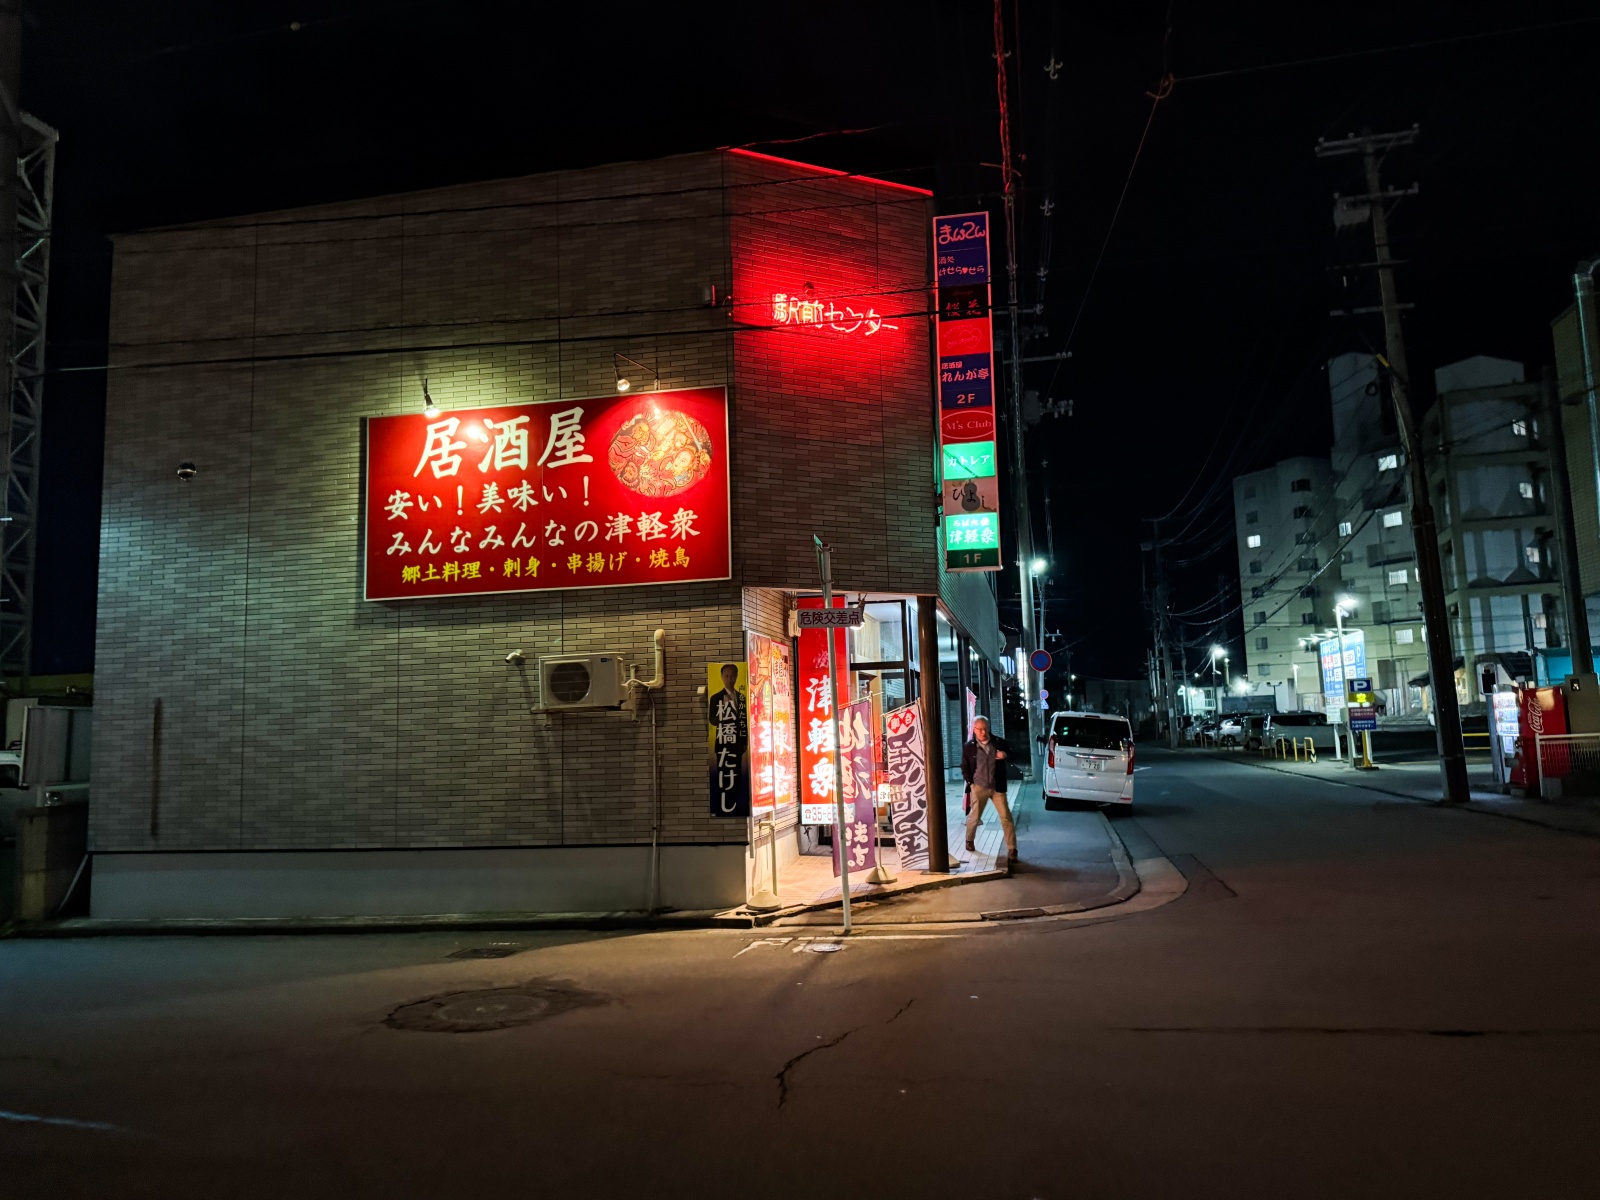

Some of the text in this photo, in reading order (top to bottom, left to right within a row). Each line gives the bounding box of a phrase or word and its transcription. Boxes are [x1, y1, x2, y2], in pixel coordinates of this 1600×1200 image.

[771, 293, 899, 336] 駅前センター
[941, 367, 990, 382] れんが亭
[957, 393, 976, 405] 2F
[946, 419, 992, 430] M's Club
[413, 406, 595, 480] 居酒屋
[948, 454, 991, 467] カトレア
[384, 475, 591, 521] 安い！美味い！
[952, 489, 988, 509] ひよし
[386, 507, 701, 557] みんなみんなの津軽衆
[401, 546, 690, 585] 郷土料理・刺身・串揚げ・焼鳥
[964, 553, 982, 564] 1F
[800, 610, 860, 625] 危険交差点
[1353, 680, 1368, 692] P
[738, 685, 747, 737] 声をかたちに
[805, 675, 838, 797] 津軽衆
[715, 699, 738, 813] 松橋たけし
